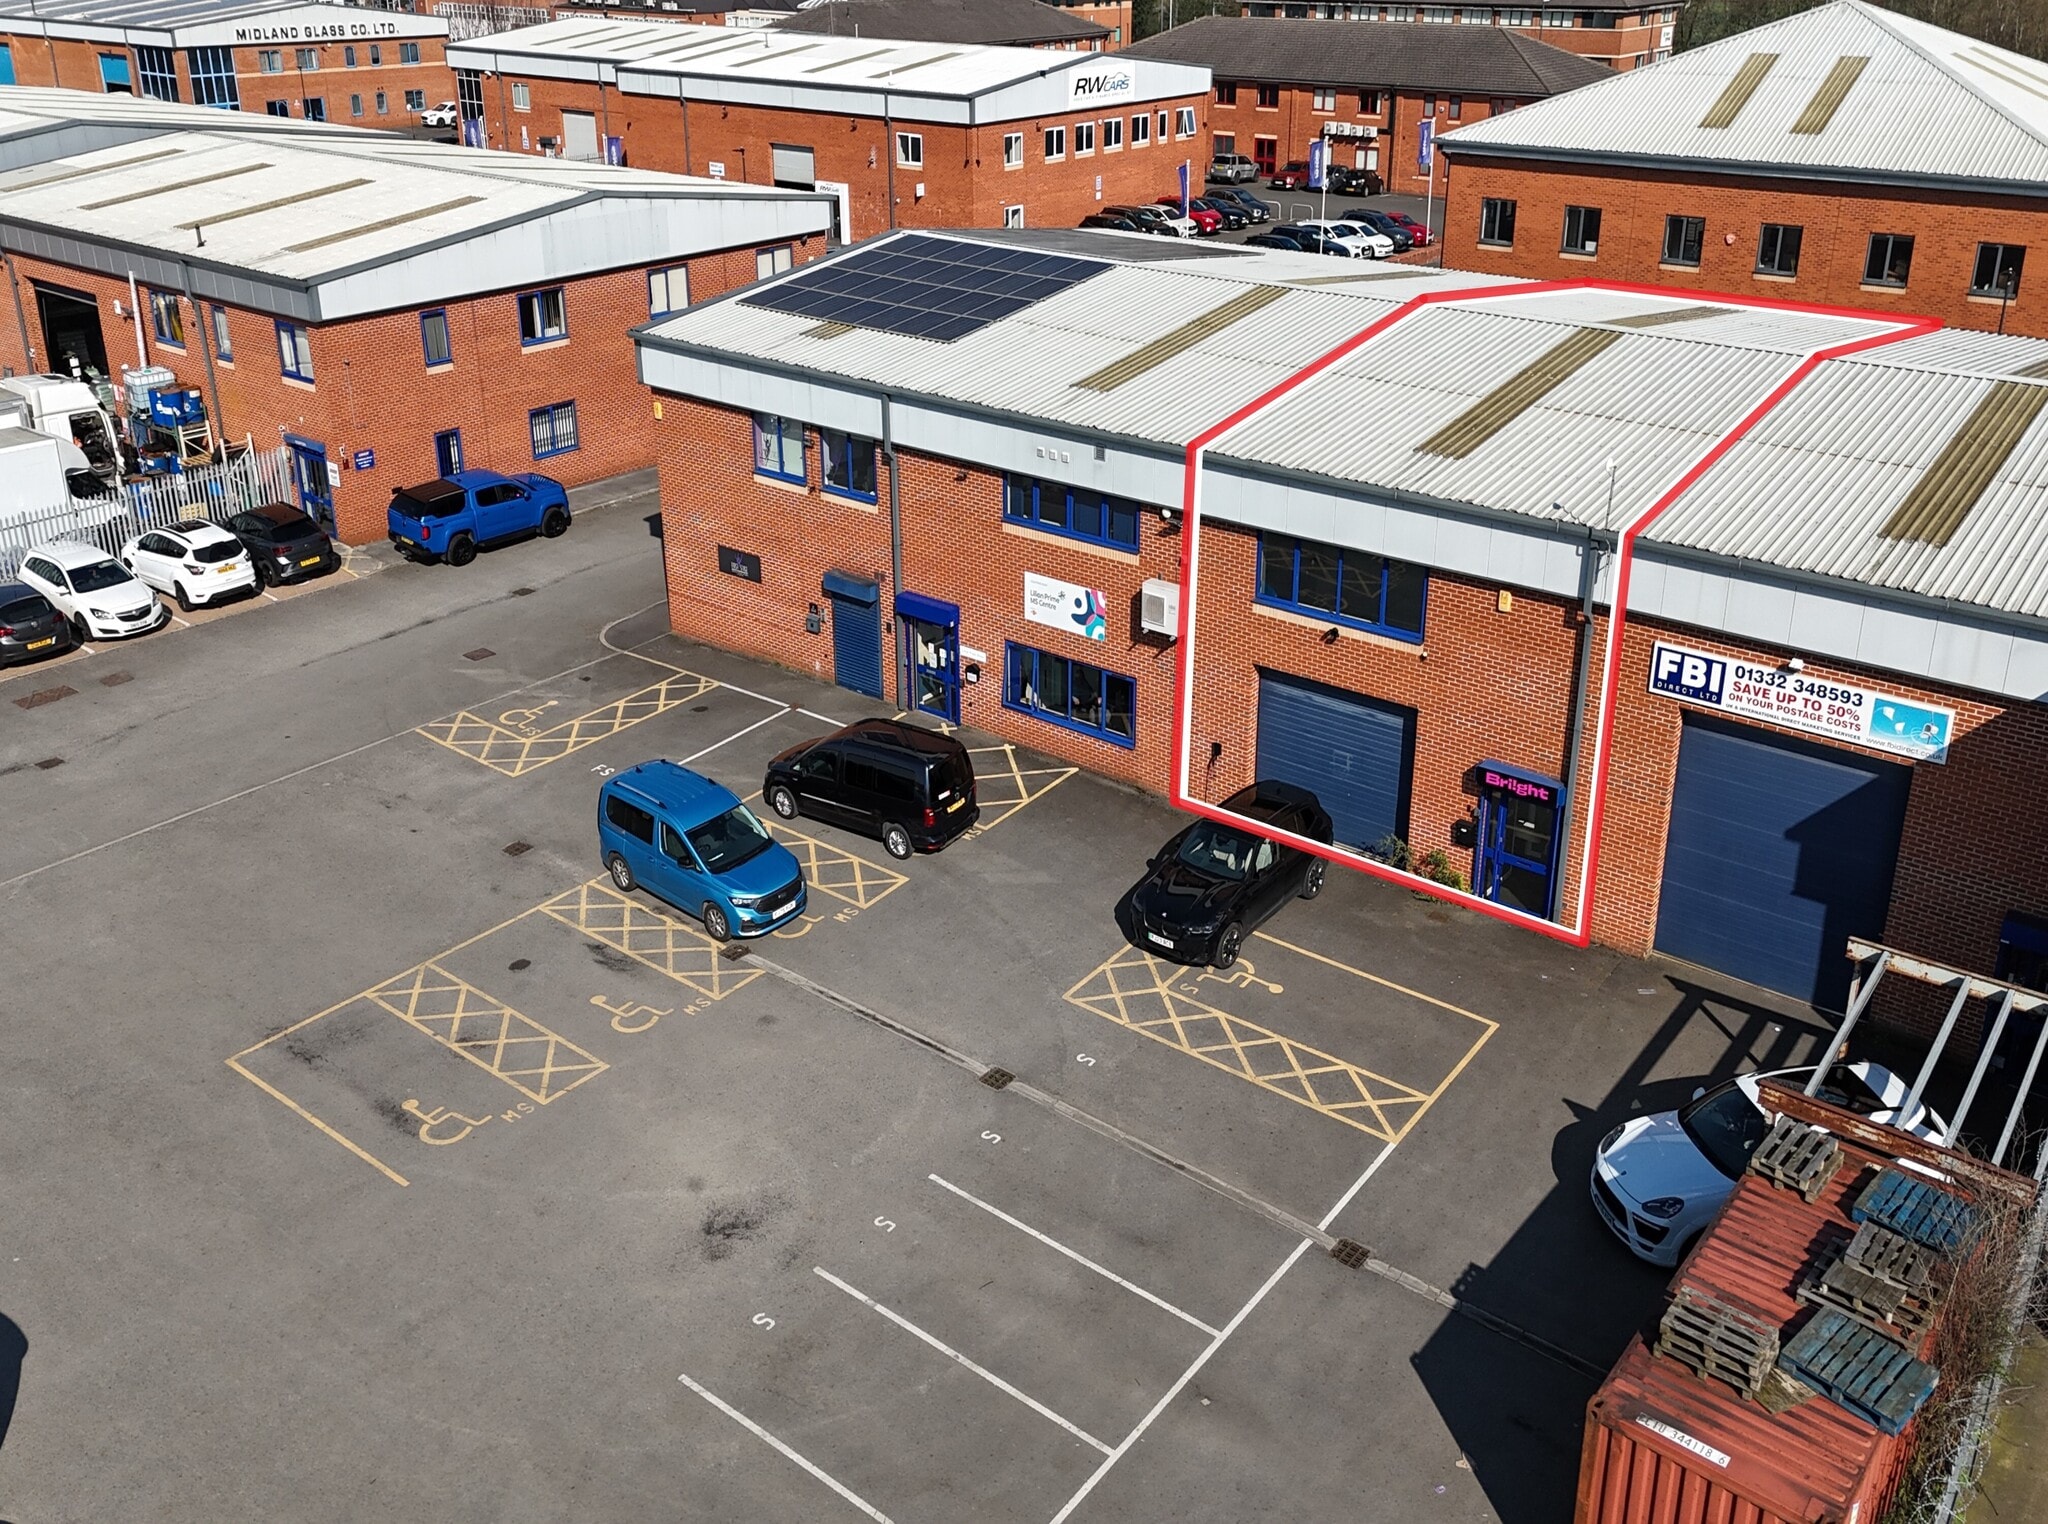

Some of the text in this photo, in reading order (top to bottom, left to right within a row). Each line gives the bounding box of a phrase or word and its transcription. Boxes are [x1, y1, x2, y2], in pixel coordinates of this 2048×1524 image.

[236, 22, 400, 41] MIDLAND GLASS CO. LTD.
[1038, 600, 1057, 611] Centre
[1658, 649, 1722, 693] FBI
[1656, 681, 1718, 702] DIRECT LTD
[1735, 665, 1864, 708] 01332 348593
[1728, 692, 1862, 732] ON YOUR POSTAGE COSTS
[1732, 681, 1860, 722] SAVE UP TO 50%
[1740, 706, 1780, 721] INTERNATIONAL
[1780, 716, 1801, 726] DIRECT
[1801, 722, 1833, 734] MARKETING
[1834, 730, 1861, 740] SERVICES
[590, 764, 616, 776] FS
[832, 907, 860, 924] MS
[682, 997, 712, 1016] MS
[500, 1102, 535, 1124] MS
[1670, 1430, 1713, 1458] 344118
[1718, 1456, 1727, 1465] 6
